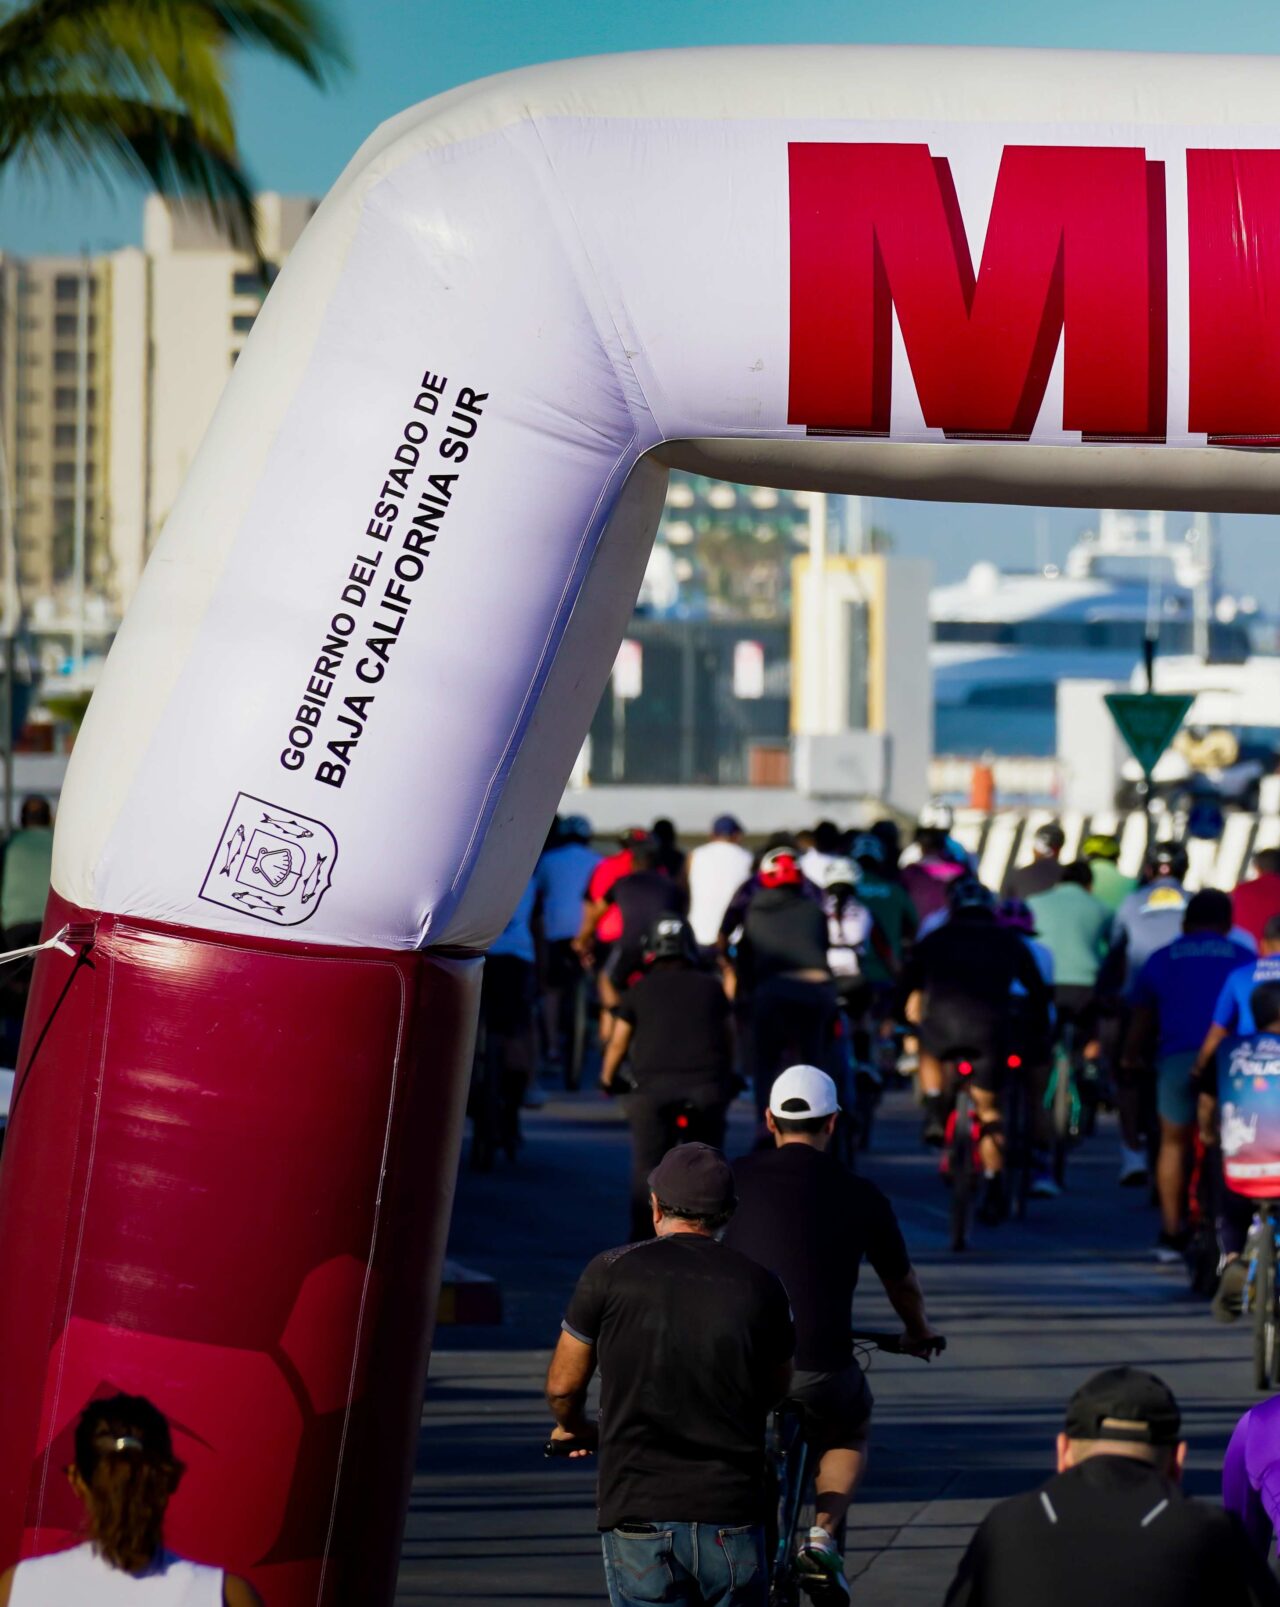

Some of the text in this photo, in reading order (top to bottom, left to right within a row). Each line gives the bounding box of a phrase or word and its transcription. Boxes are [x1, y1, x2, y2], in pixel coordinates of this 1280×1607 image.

[280, 370, 448, 771] GOBIERNO DEL ESTADO DE
[314, 387, 489, 789] BAJA CALIFORNIA SUR
